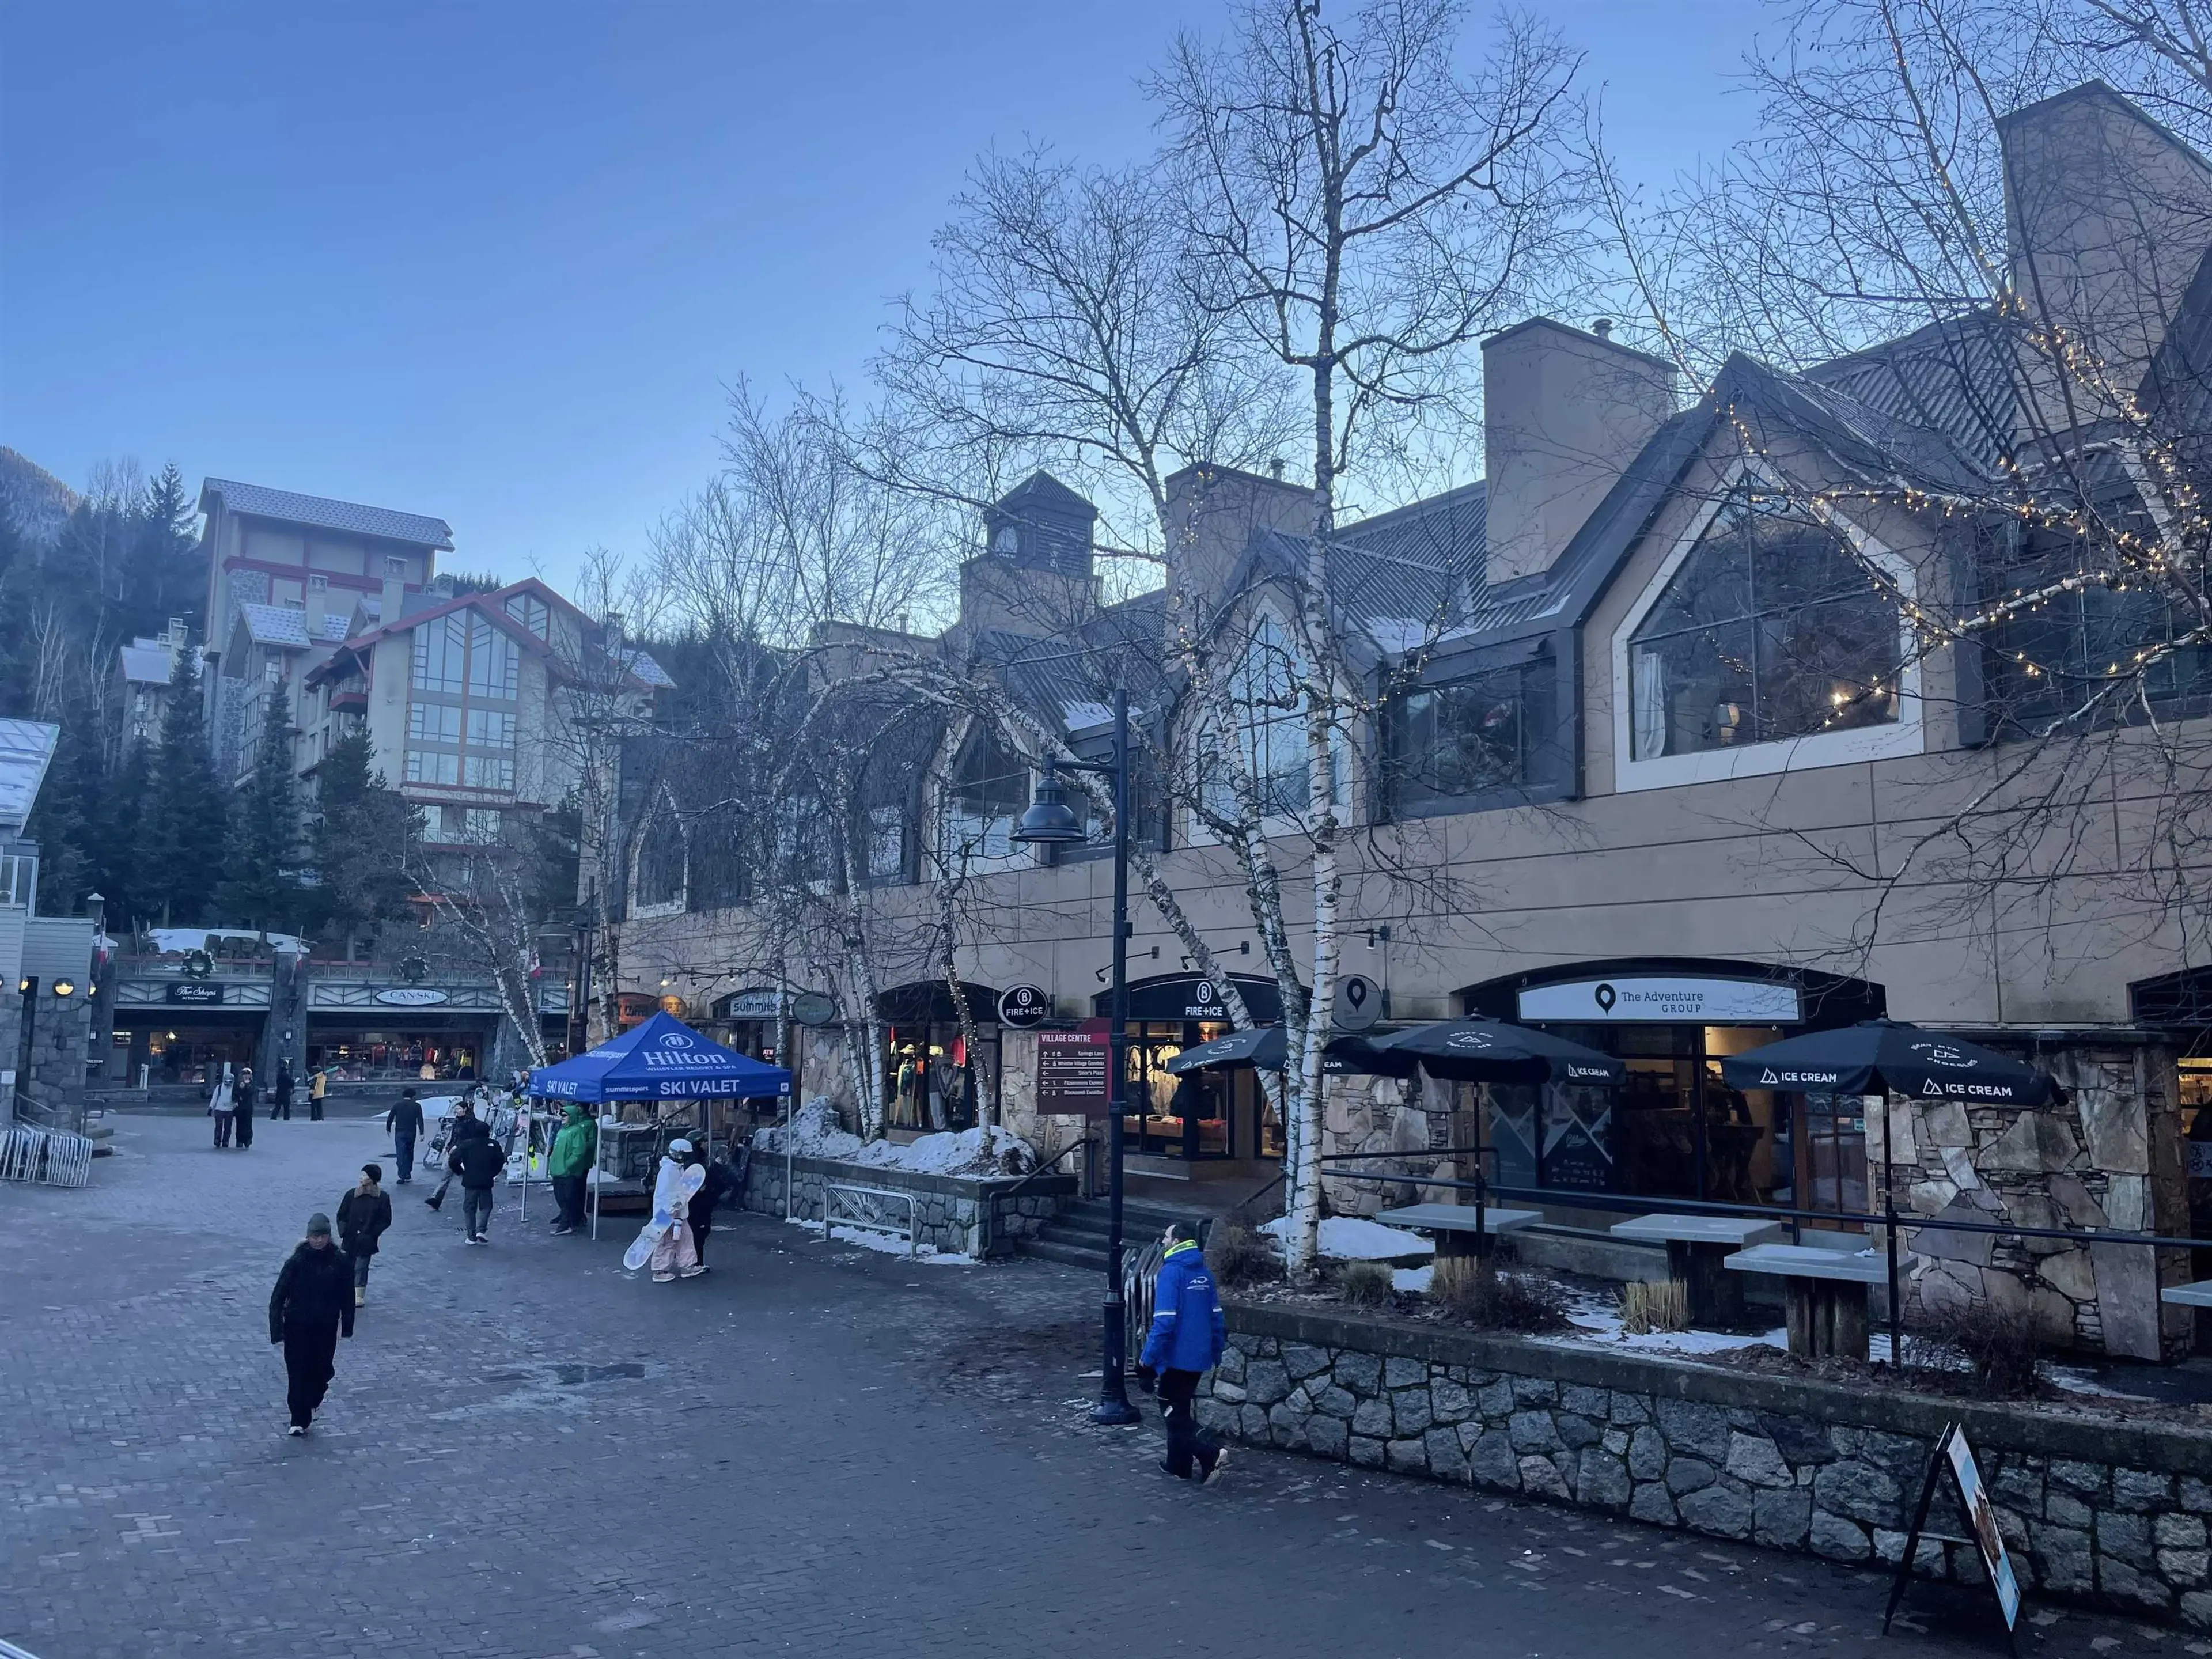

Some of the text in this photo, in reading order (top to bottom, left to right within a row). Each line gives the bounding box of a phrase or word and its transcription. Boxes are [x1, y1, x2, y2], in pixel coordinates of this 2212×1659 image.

[1621, 991, 1703, 1002] The Adventure
[1006, 1007, 1043, 1017] FIRE+ICE
[1185, 1006, 1222, 1016] FIRE+ICE
[1661, 1004, 1702, 1013] GROUP
[1041, 1034, 1092, 1043] VILLAGE CENTRE
[642, 1051, 728, 1065] Hilton
[1577, 1067, 1609, 1077] ICE CREAM
[1781, 1071, 1837, 1083] ICE CREAM
[546, 1080, 558, 1094] SKI
[558, 1081, 578, 1095] VALET
[660, 1079, 740, 1095] SKI VALET
[1945, 1083, 2012, 1096] ICE CREAM
